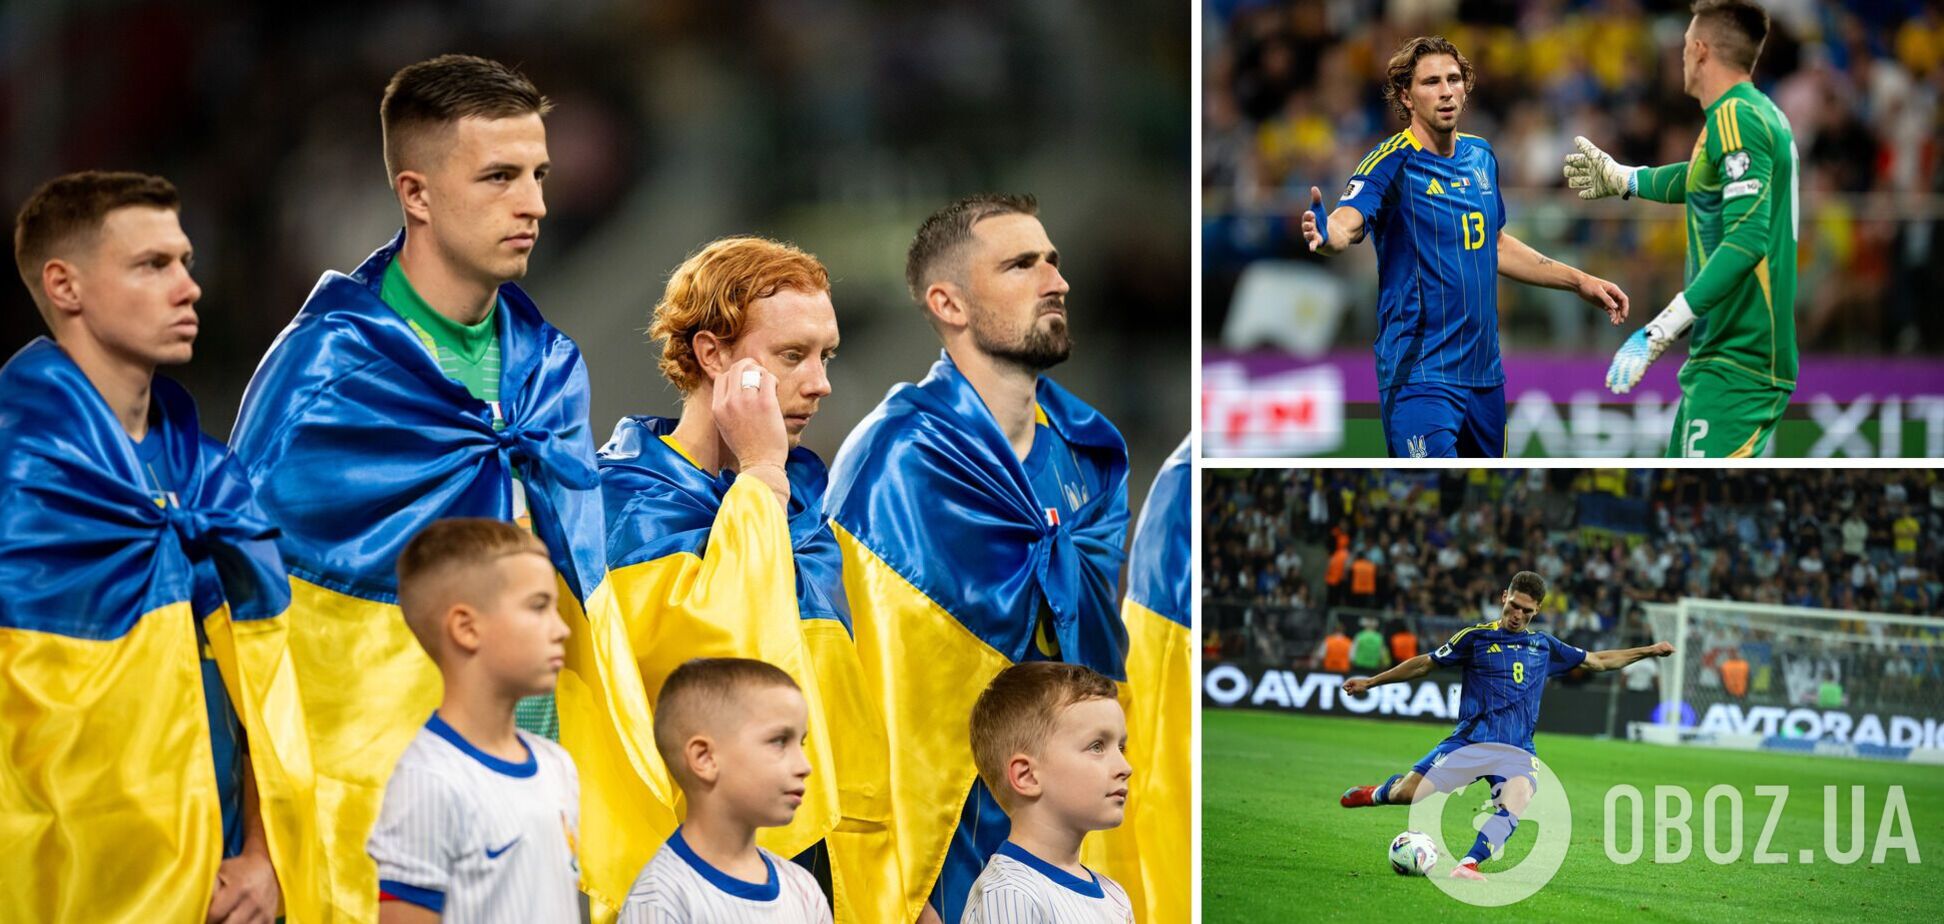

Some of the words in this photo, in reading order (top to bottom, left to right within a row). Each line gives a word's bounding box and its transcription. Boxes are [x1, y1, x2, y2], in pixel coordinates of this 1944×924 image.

[1461, 211, 1486, 250] 13
[1512, 661, 1524, 684] 8
[1700, 702, 1944, 750] AVTORADI
